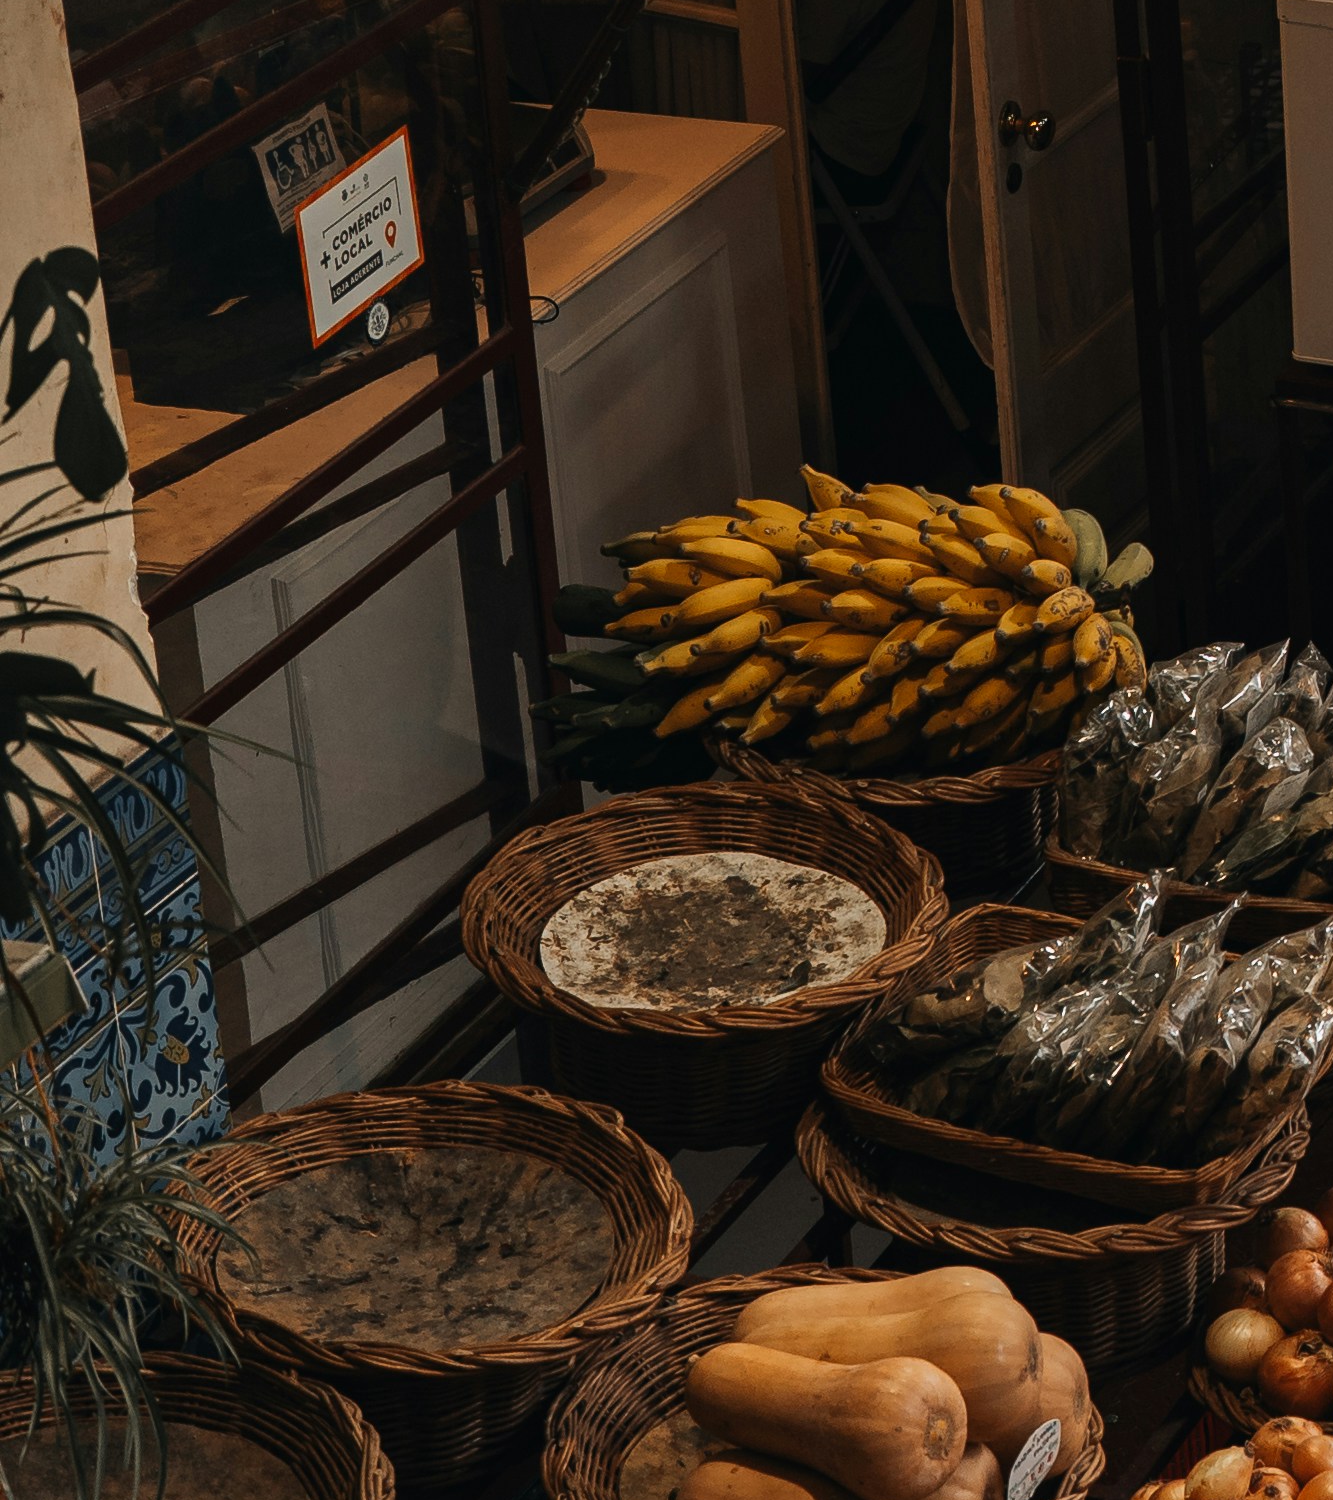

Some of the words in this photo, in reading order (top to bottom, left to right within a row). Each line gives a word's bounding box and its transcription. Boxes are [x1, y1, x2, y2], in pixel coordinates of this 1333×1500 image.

[332, 196, 392, 250] COMÉRCIO
[334, 233, 373, 271] LOCAL
[333, 280, 350, 299] LOJA
[350, 256, 381, 285] ADERENTE
